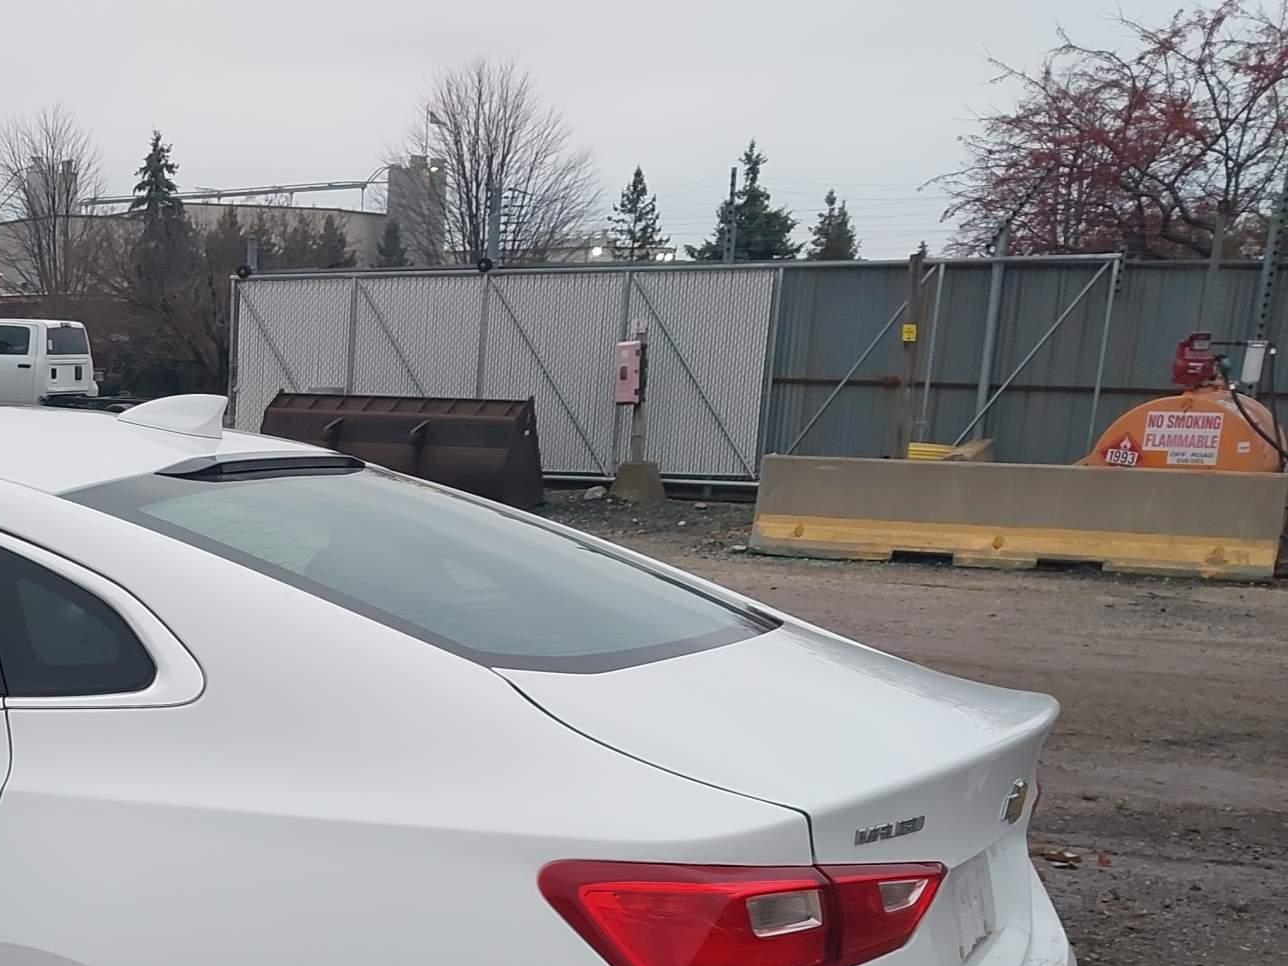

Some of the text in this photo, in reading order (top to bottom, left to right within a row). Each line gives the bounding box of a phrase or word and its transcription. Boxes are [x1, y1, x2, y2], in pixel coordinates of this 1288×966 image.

[1148, 414, 1222, 430] NO SMOKING
[1145, 433, 1218, 448] FLAMMABLE
[1109, 450, 1136, 465] 1993
[855, 814, 926, 846] MALIBU
